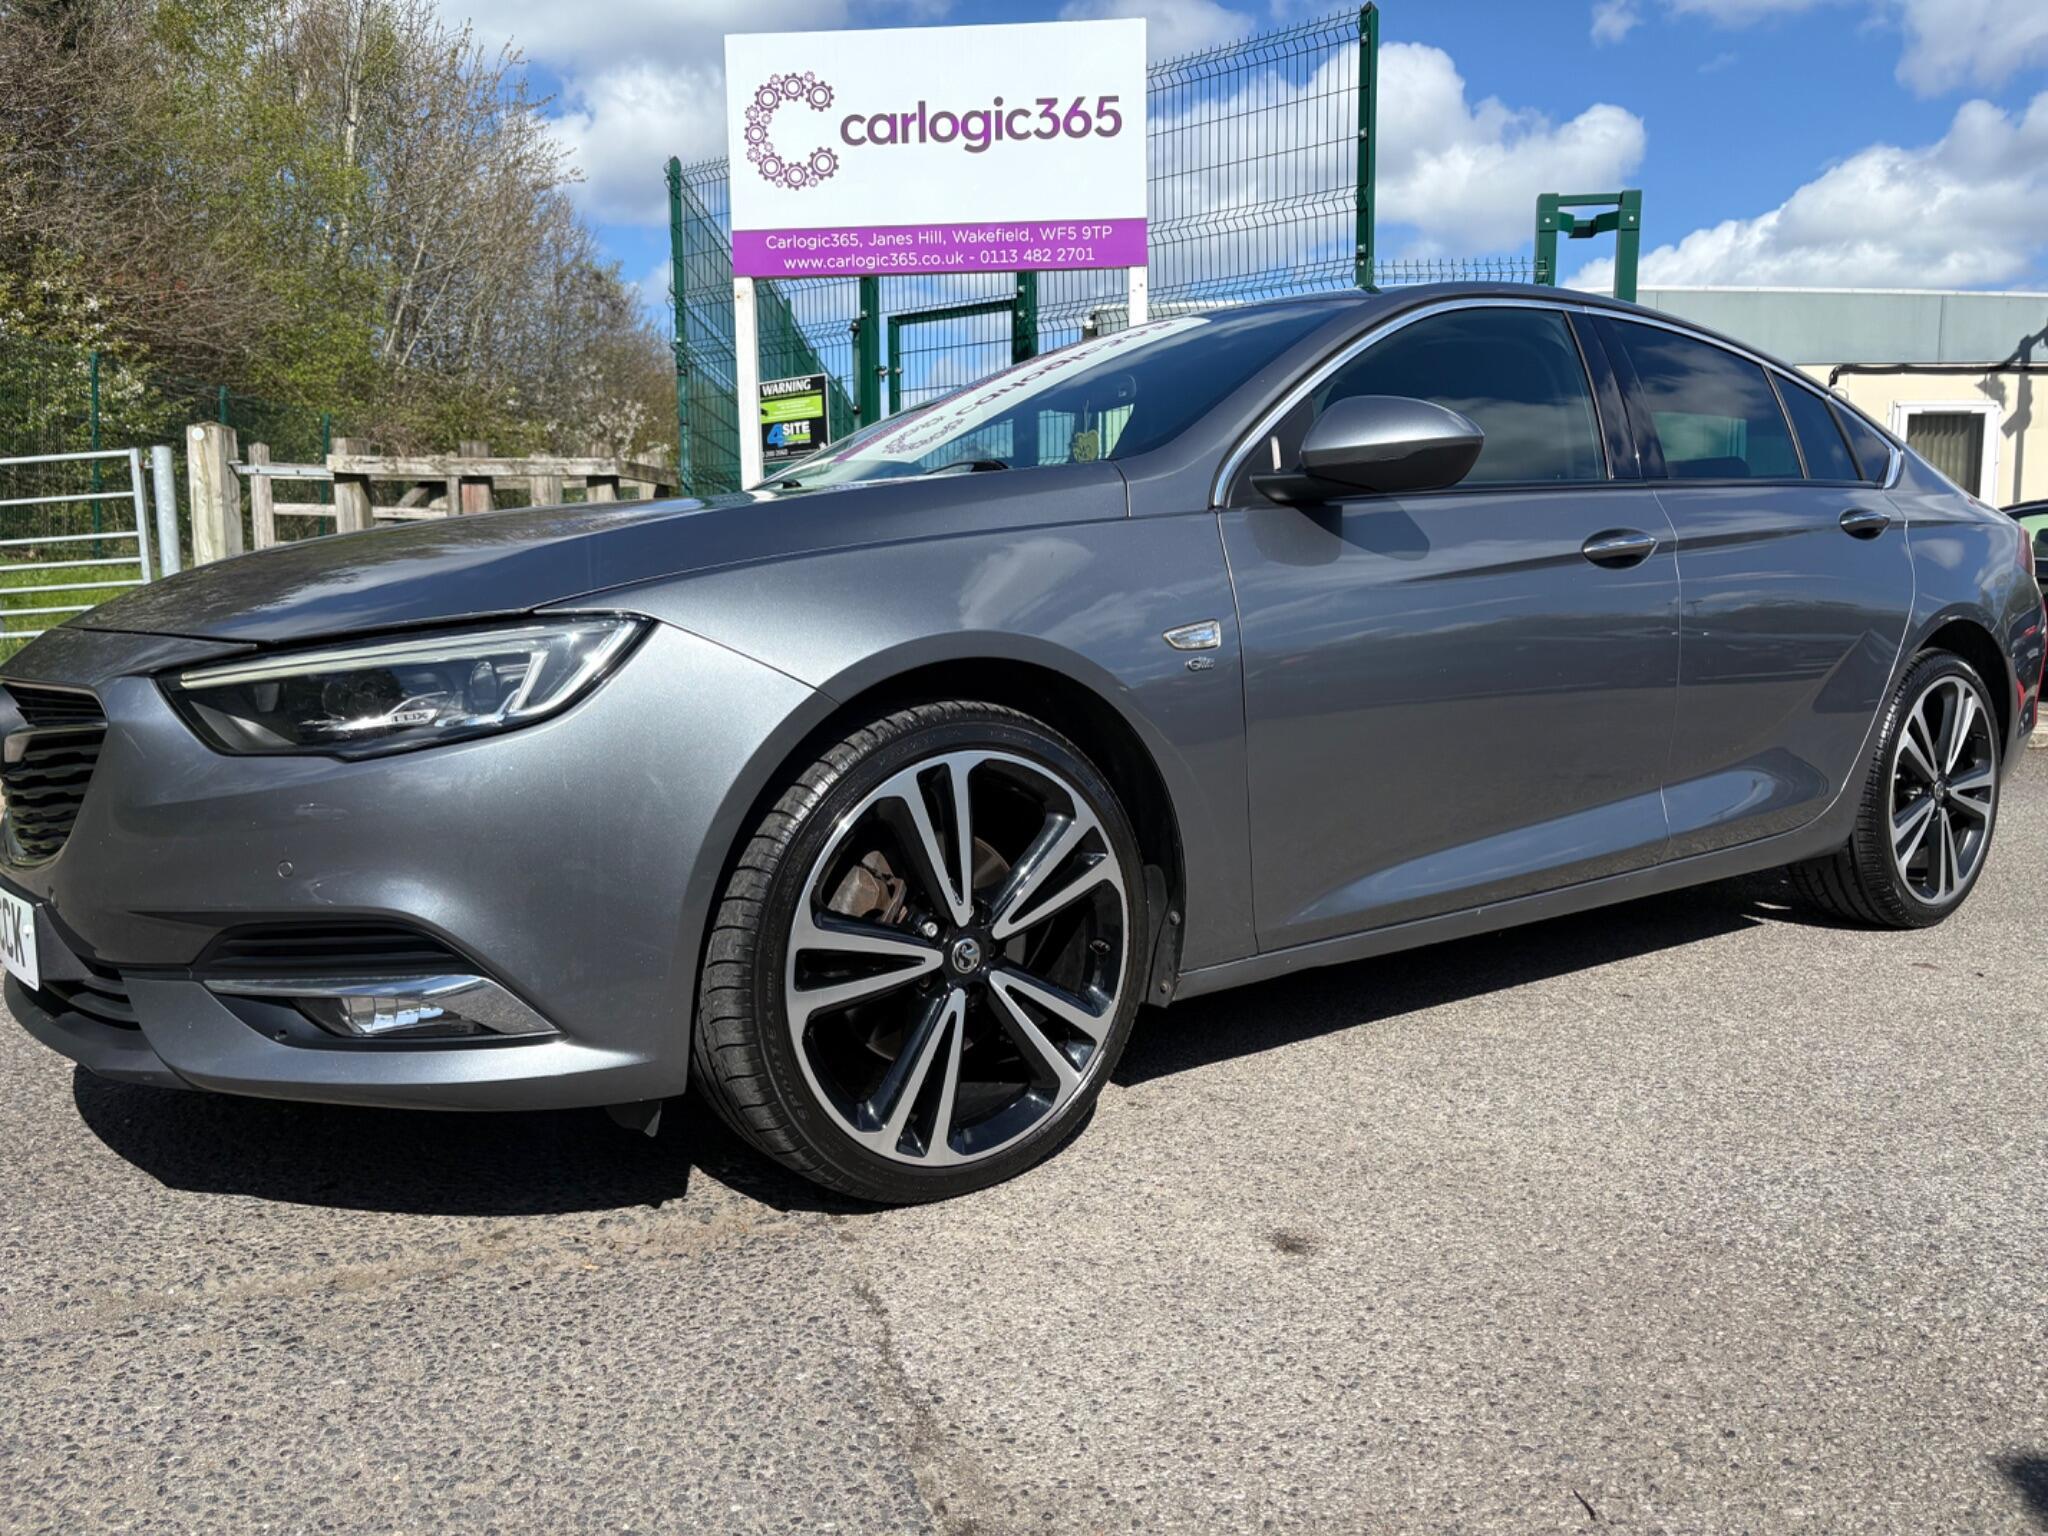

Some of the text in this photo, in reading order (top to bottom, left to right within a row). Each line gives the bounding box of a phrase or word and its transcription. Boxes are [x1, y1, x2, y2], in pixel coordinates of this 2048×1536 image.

[840, 95, 1123, 154] carlogic365
[765, 225, 1112, 250] Carlogic365, Janes Hill, Wakefield, WF5 9TP
[783, 251, 964, 270] www.carlogic365.co.uk
[980, 249, 1018, 264] 0113
[1023, 249, 1052, 263] 482
[1056, 247, 1095, 261] 2701
[762, 378, 811, 396] WARNING
[0, 897, 25, 968] CK
